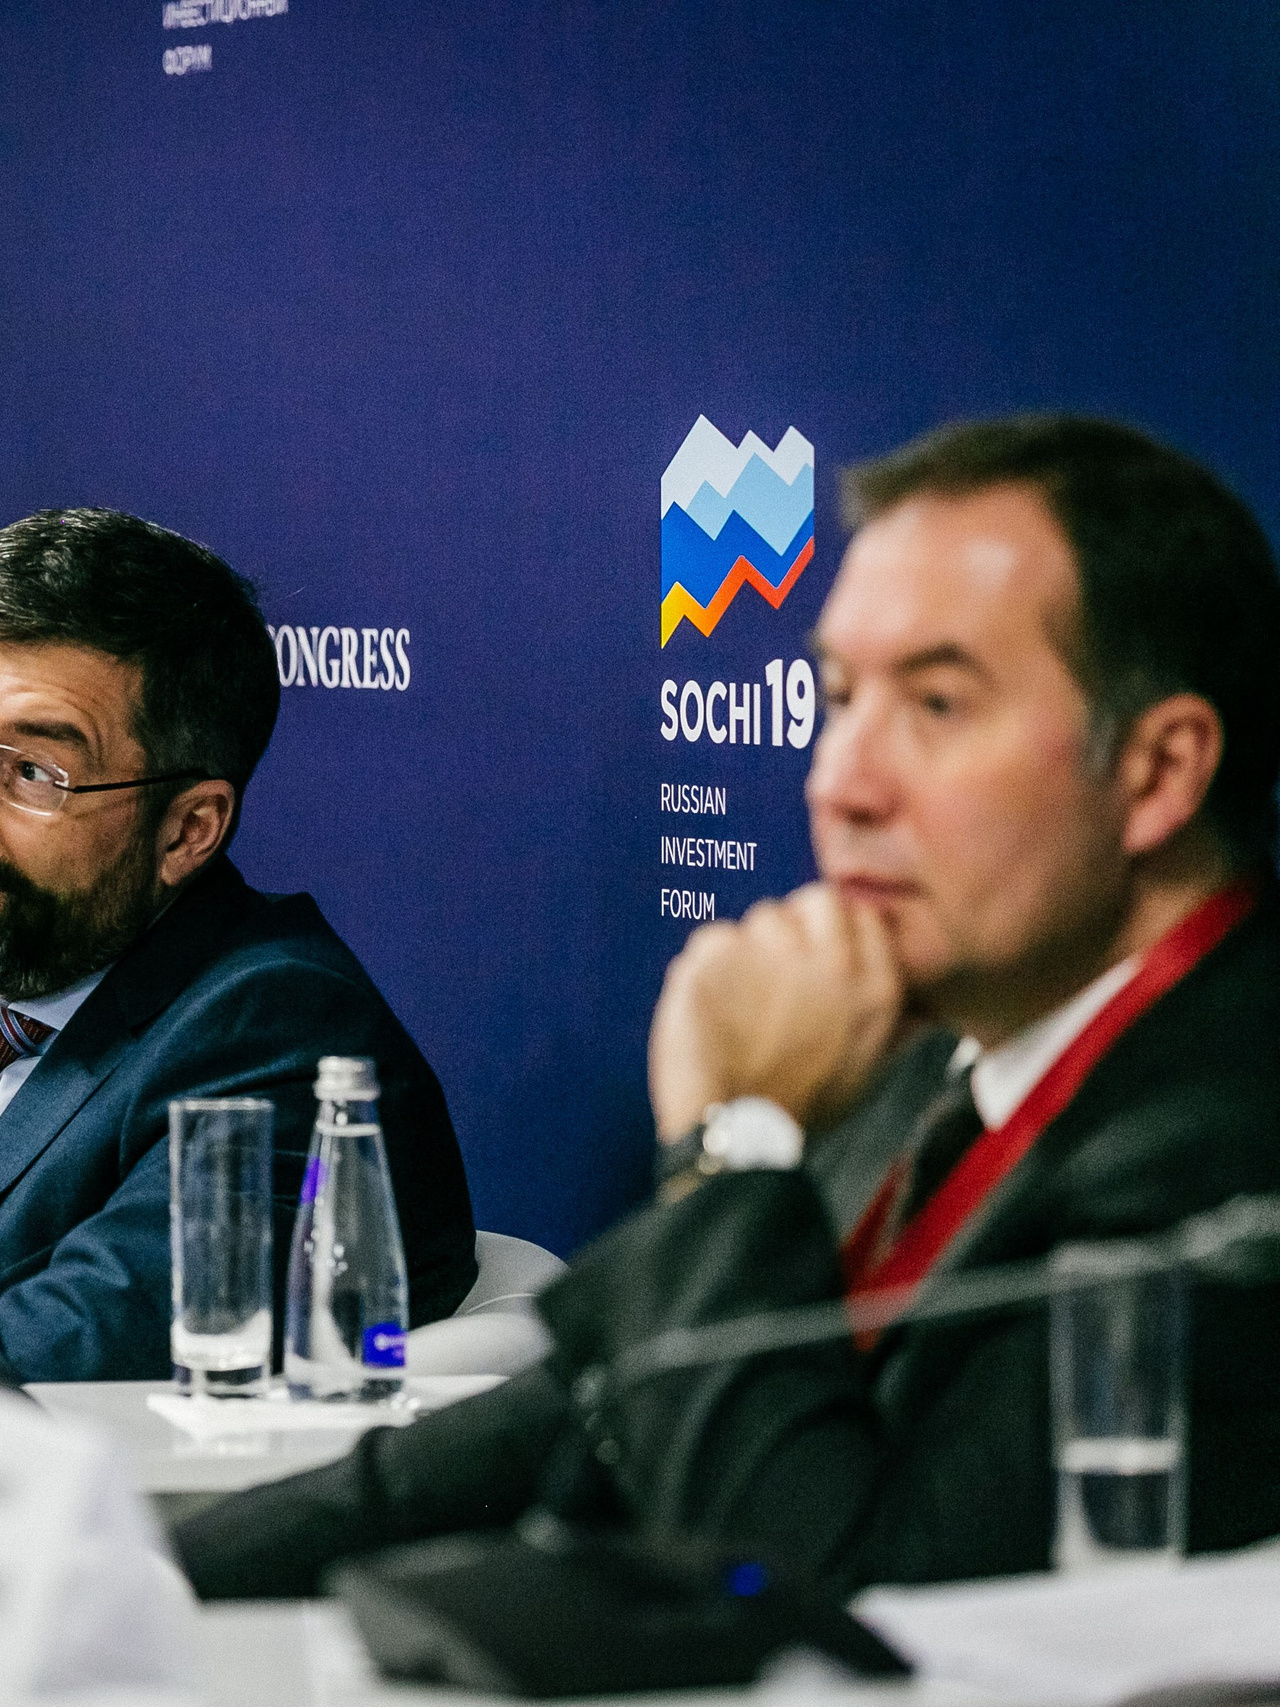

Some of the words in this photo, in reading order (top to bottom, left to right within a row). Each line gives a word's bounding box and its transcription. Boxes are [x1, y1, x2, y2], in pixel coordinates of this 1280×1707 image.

[266, 624, 411, 692] ONGRESS
[660, 783, 727, 816] RUSSIAN
[660, 835, 758, 872] INVESTMENT
[660, 888, 716, 921] FORUM
